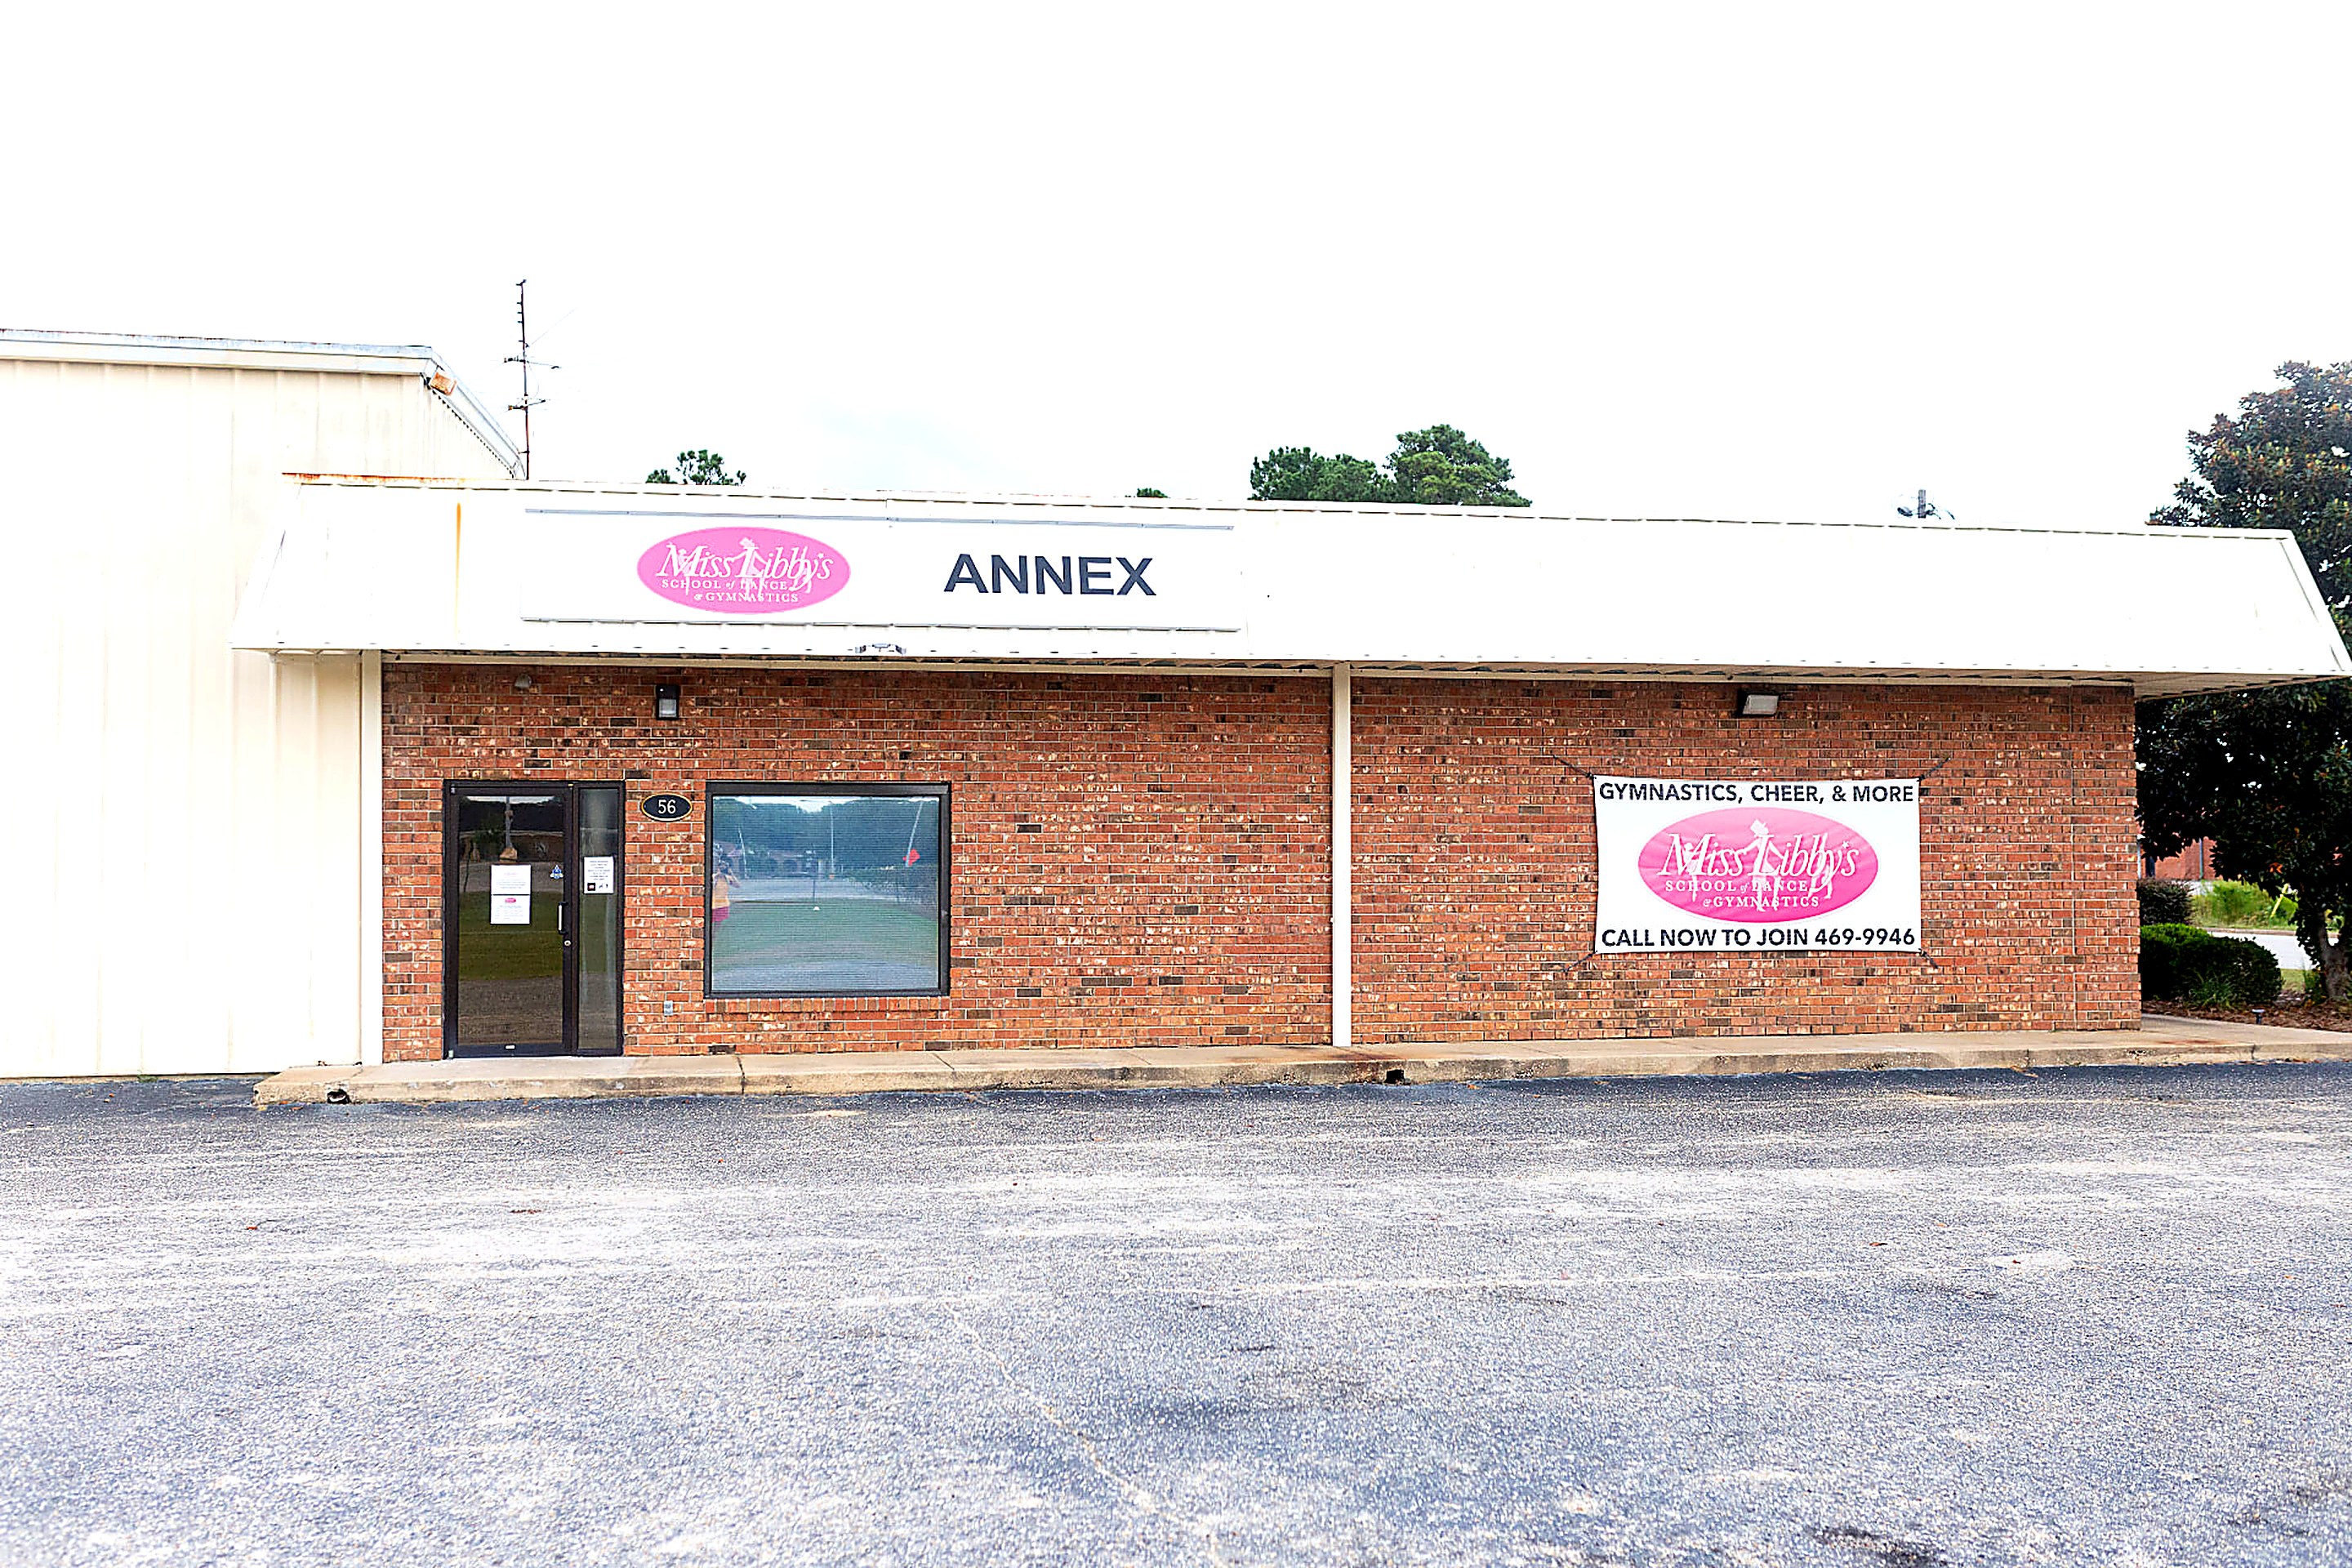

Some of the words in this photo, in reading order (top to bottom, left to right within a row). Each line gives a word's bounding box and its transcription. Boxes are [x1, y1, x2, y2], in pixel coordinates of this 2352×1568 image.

[656, 544, 734, 579] Miss
[735, 546, 834, 592] Libby's
[944, 554, 1156, 596] ANNEX
[662, 579, 722, 590] SCHOOL
[726, 580, 736, 590] of
[740, 581, 788, 590] DANCE
[706, 593, 799, 603] GYMNASTICS
[1599, 782, 1743, 804] GYMNASTICS,
[1750, 785, 1824, 804] CHEER,
[1832, 786, 1846, 802] &
[1853, 786, 1913, 802] MORE
[657, 800, 676, 814] 56
[1656, 833, 1747, 877] Miss
[1748, 832, 1860, 893] Libby's
[1665, 880, 1737, 892] SCHOOL
[1740, 881, 1750, 893] of
[1752, 880, 1808, 892] DANCE
[1713, 896, 1819, 907] GYMNASTICS
[1601, 929, 1655, 947] CALL
[1660, 929, 1717, 947] NOW
[1722, 929, 1751, 946] TO
[1757, 929, 1807, 946] JOIN
[1815, 928, 1915, 946] 469-9946
